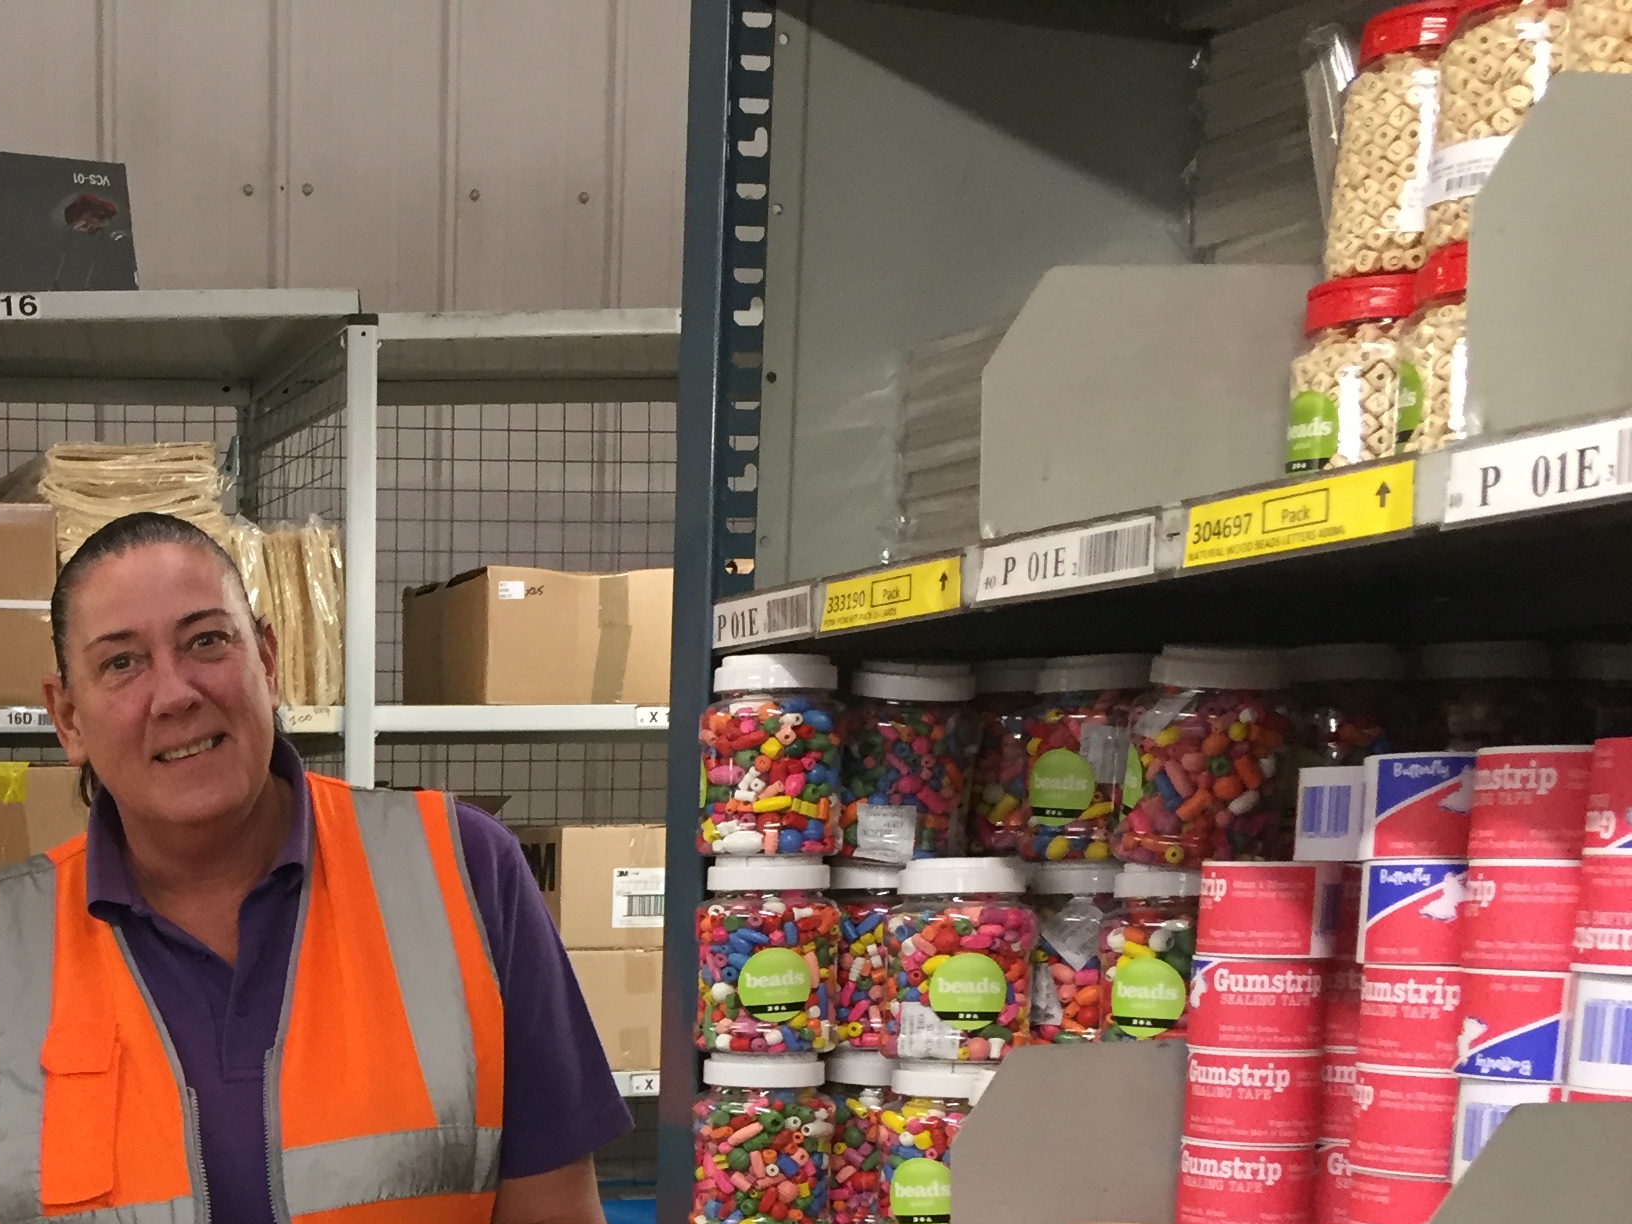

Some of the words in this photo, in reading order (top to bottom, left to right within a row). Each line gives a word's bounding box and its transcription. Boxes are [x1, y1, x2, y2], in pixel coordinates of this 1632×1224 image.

[73, 172, 111, 187] VCS-01
[0, 294, 39, 318] 16
[1479, 464, 1501, 507] P
[1531, 446, 1601, 498] 01E
[1192, 512, 1253, 545] 304697
[1281, 505, 1311, 524] Pack
[1003, 557, 1016, 586] P
[1027, 547, 1066, 581] 01E
[827, 590, 865, 614] 333190
[882, 586, 900, 601] Pack
[717, 614, 727, 643] P
[731, 608, 759, 638] 01E
[7, 712, 33, 725] 16D
[649, 711, 658, 723] X
[1393, 761, 1449, 779] Butterfly
[1033, 774, 1088, 792] beads
[1380, 868, 1430, 887] Butterfly
[745, 969, 805, 988] beads
[938, 976, 1002, 995] beads
[1214, 967, 1322, 1000] Gumstrip
[1116, 982, 1178, 1002] beads
[1220, 993, 1278, 1006] SEALING
[1282, 994, 1311, 1007] TAPE
[1475, 1052, 1532, 1077] Butterfly
[644, 1079, 654, 1090] X
[1189, 1059, 1290, 1093] Gumstrip
[1244, 1087, 1272, 1101] TAPE
[1181, 1149, 1282, 1185] Gumstrip
[894, 1181, 950, 1198] beads
[1229, 1180, 1264, 1194] TAPE
